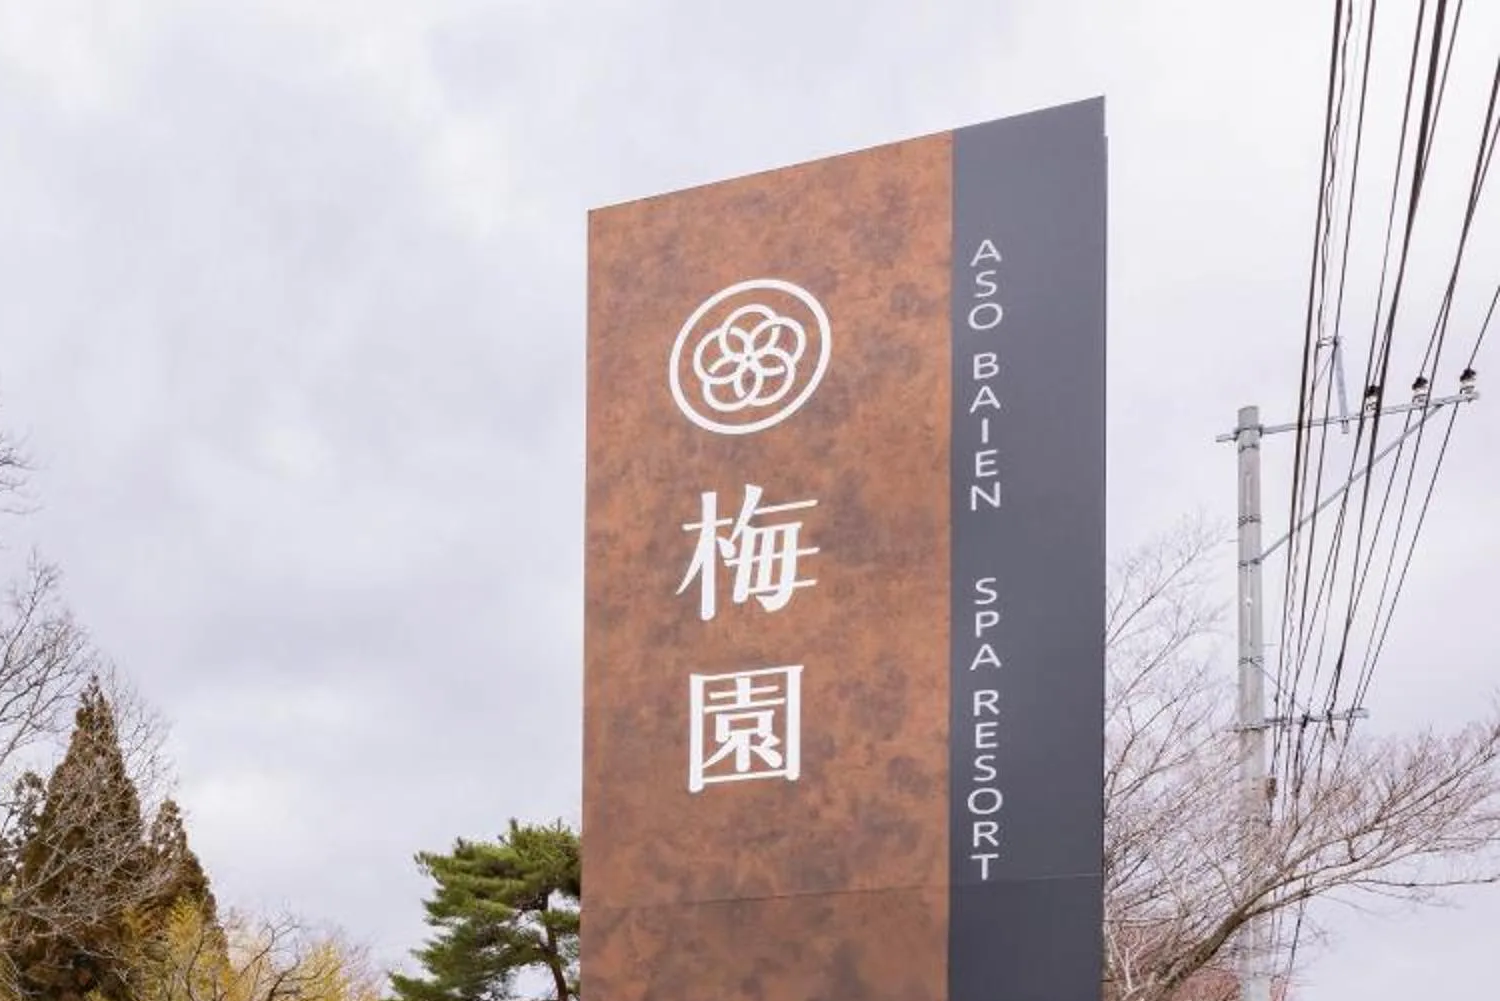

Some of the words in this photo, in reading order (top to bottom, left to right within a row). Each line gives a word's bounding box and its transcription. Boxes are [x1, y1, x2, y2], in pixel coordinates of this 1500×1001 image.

[968, 238, 1003, 331] ASO
[968, 351, 1002, 511] BAIEN
[676, 483, 820, 792] 梅園
[969, 576, 1002, 670] SPA
[968, 689, 1003, 880] RESORT
